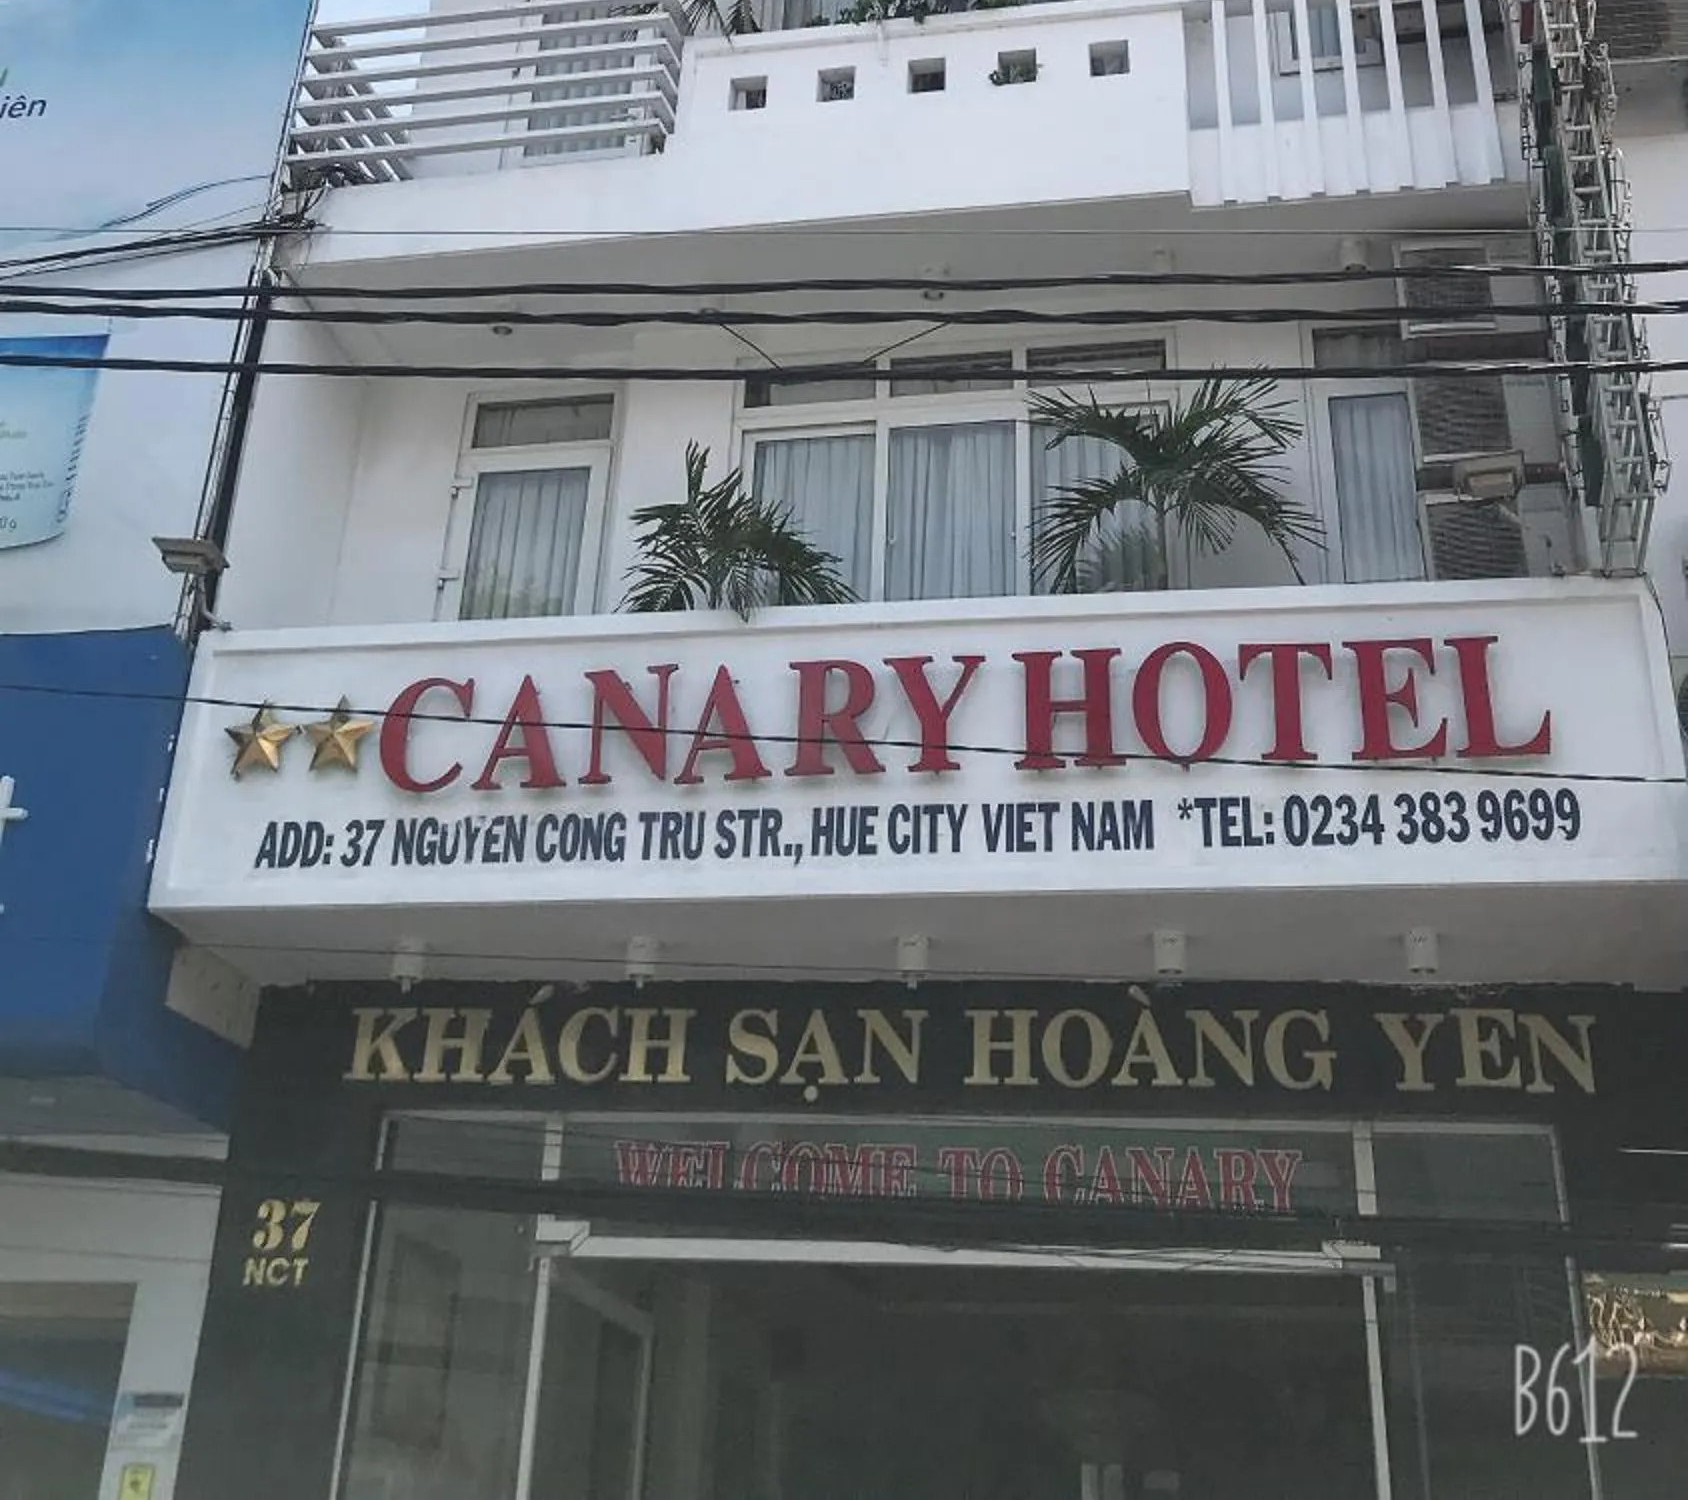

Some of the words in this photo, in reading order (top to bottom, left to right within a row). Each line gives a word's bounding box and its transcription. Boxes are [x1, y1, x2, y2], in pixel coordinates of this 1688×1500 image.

[379, 654, 987, 793] CANARY
[1012, 635, 1551, 772] HOTEL
[254, 821, 333, 869] ADD:
[340, 819, 384, 866] 37
[391, 814, 528, 867] NGUYEN
[536, 811, 626, 863] CONG
[639, 810, 706, 861] TRU
[713, 807, 803, 866] STR.,
[811, 805, 879, 857] HUE
[888, 803, 968, 854] CITY
[982, 801, 1060, 853] VIET
[1071, 799, 1154, 851] NAM
[1283, 793, 1385, 847] 0234
[1394, 790, 1470, 845] 383
[1477, 787, 1581, 842] 9699
[342, 985, 697, 1086] KHÁCH
[725, 1008, 929, 1103] SẠN
[963, 985, 1337, 1092] HOÀNG
[1374, 1008, 1597, 1094] YEN
[938, 1146, 1024, 1200] TO
[1042, 1145, 1302, 1214] CANARY
[253, 1199, 321, 1251] 37
[242, 1257, 309, 1286] NCT
